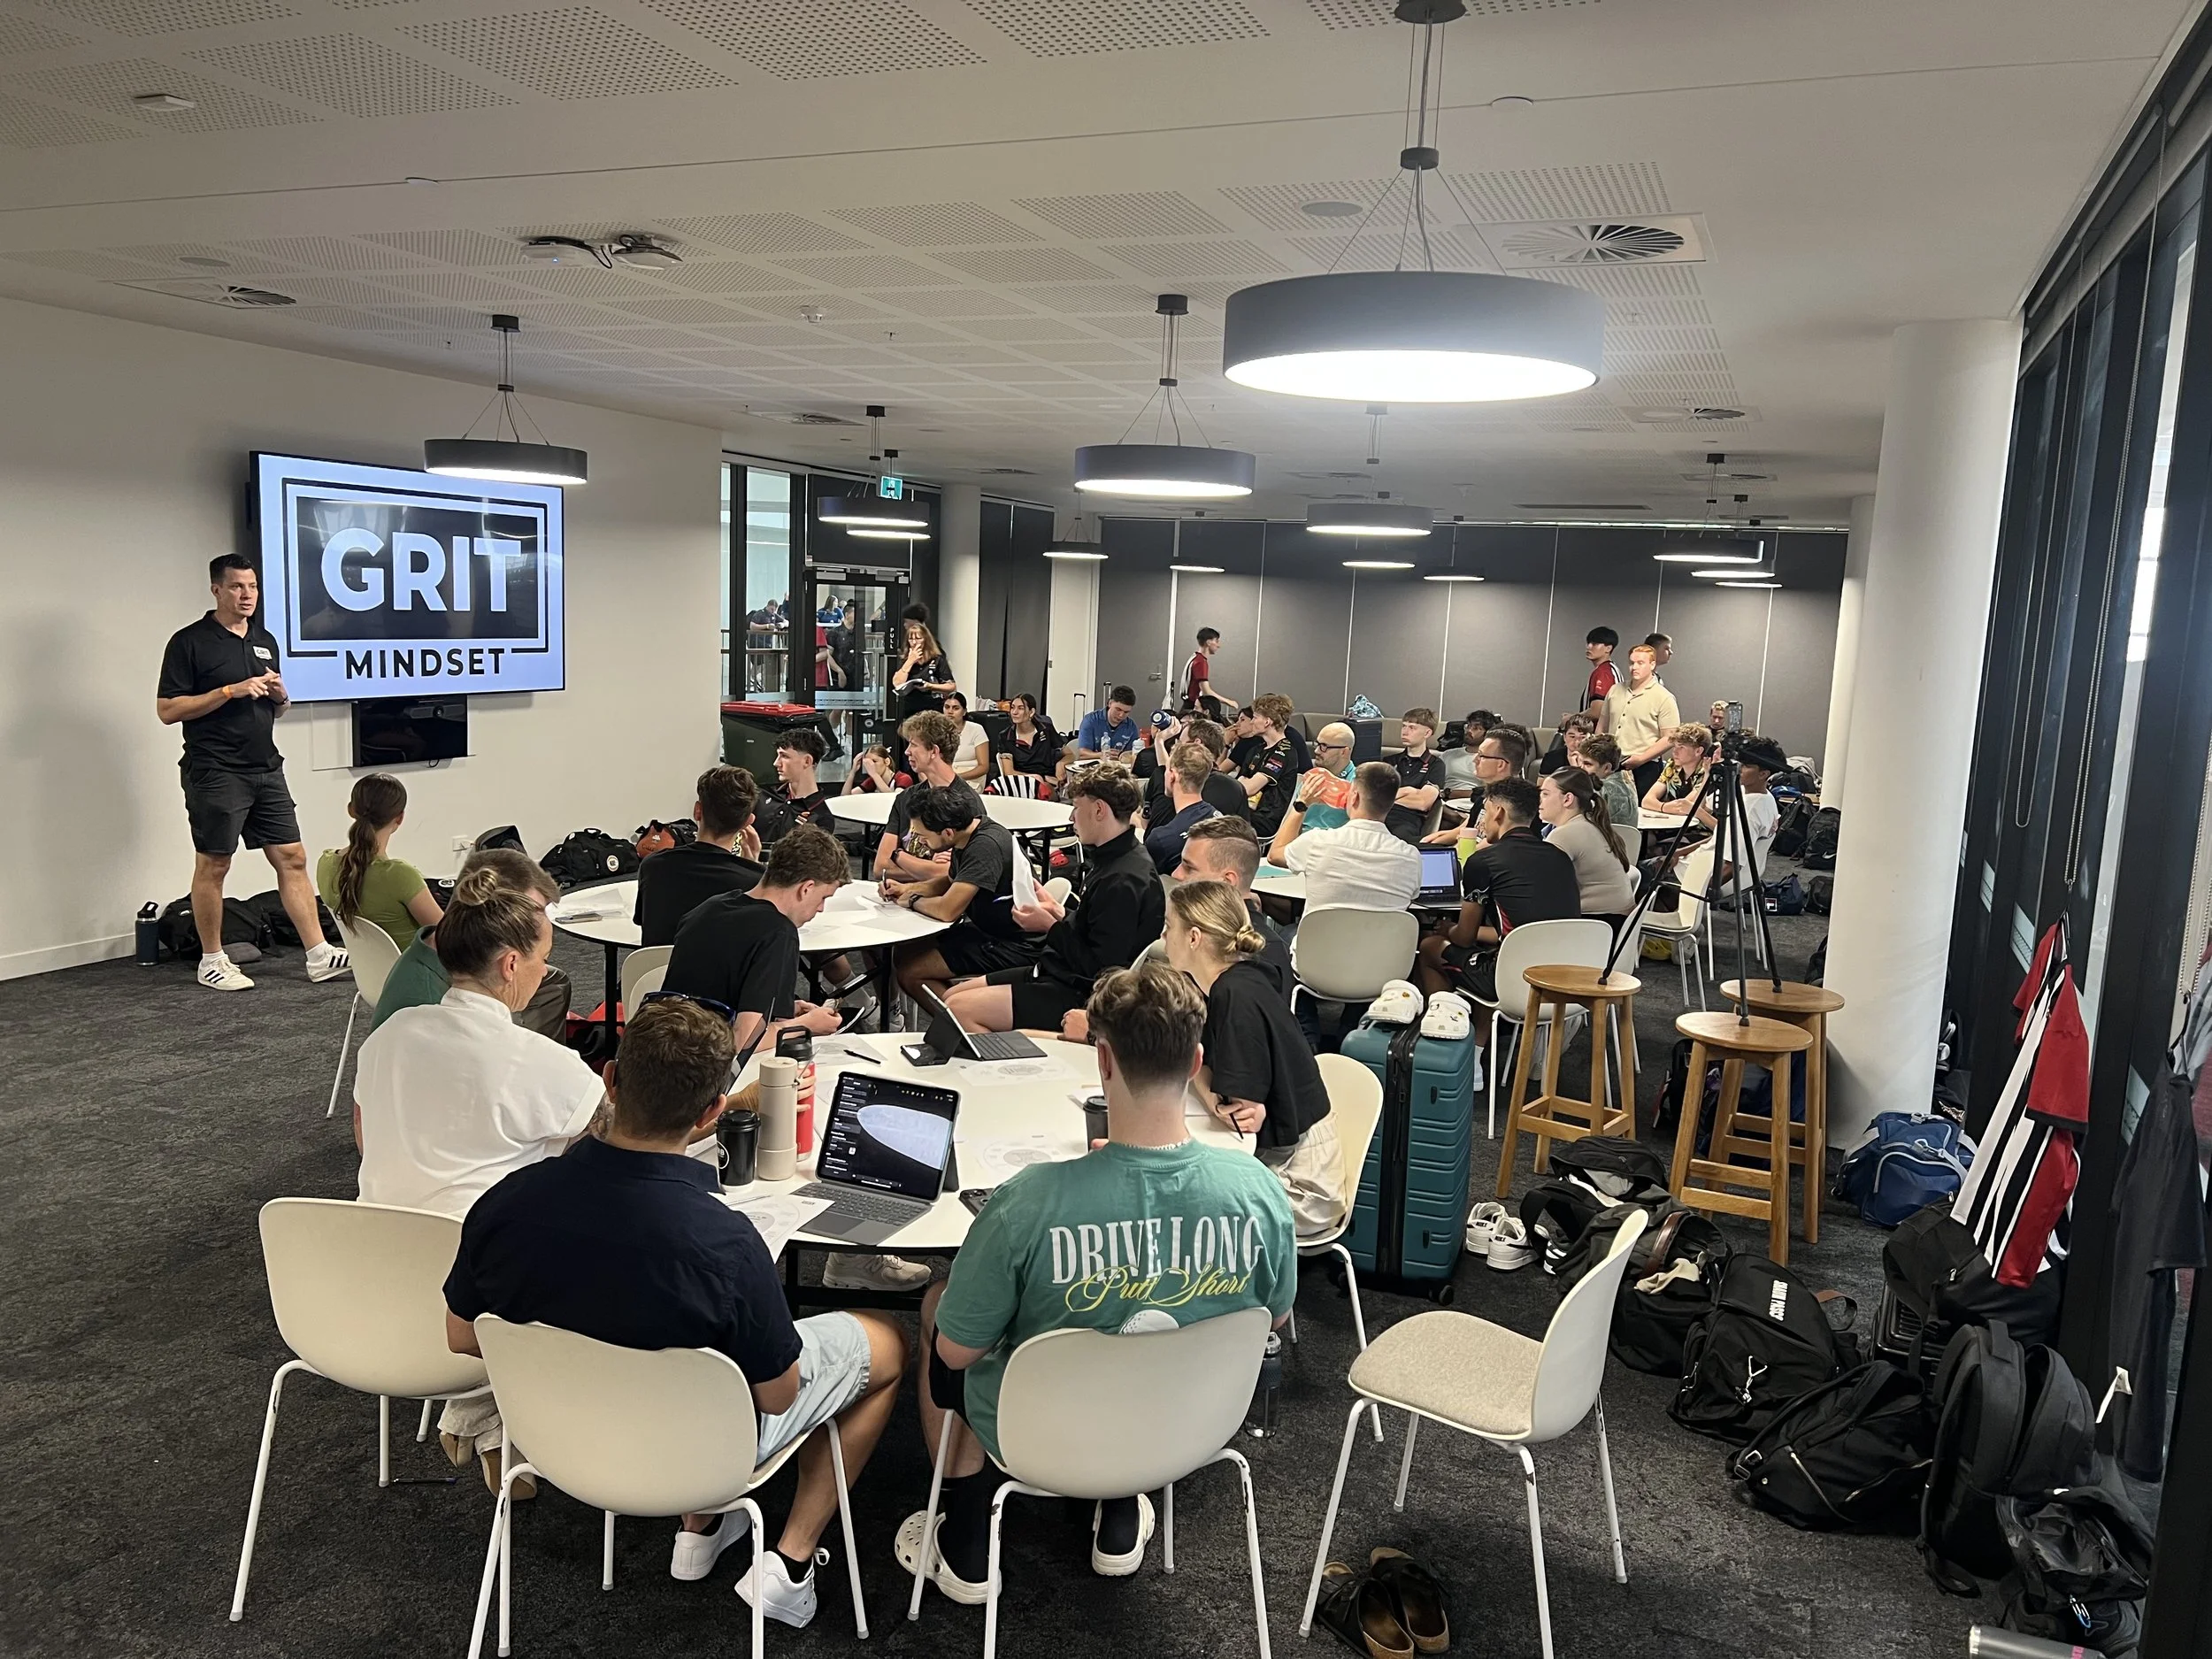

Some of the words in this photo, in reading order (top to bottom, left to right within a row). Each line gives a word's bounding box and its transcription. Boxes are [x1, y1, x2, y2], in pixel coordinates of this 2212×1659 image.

[321, 527, 521, 611] GRIT
[345, 649, 505, 680] MINDSET
[1049, 1217, 1163, 1284] DRIVE
[1170, 1216, 1263, 1275] LONG
[1065, 1264, 1160, 1312] Putt
[1142, 1261, 1252, 1307] Short
